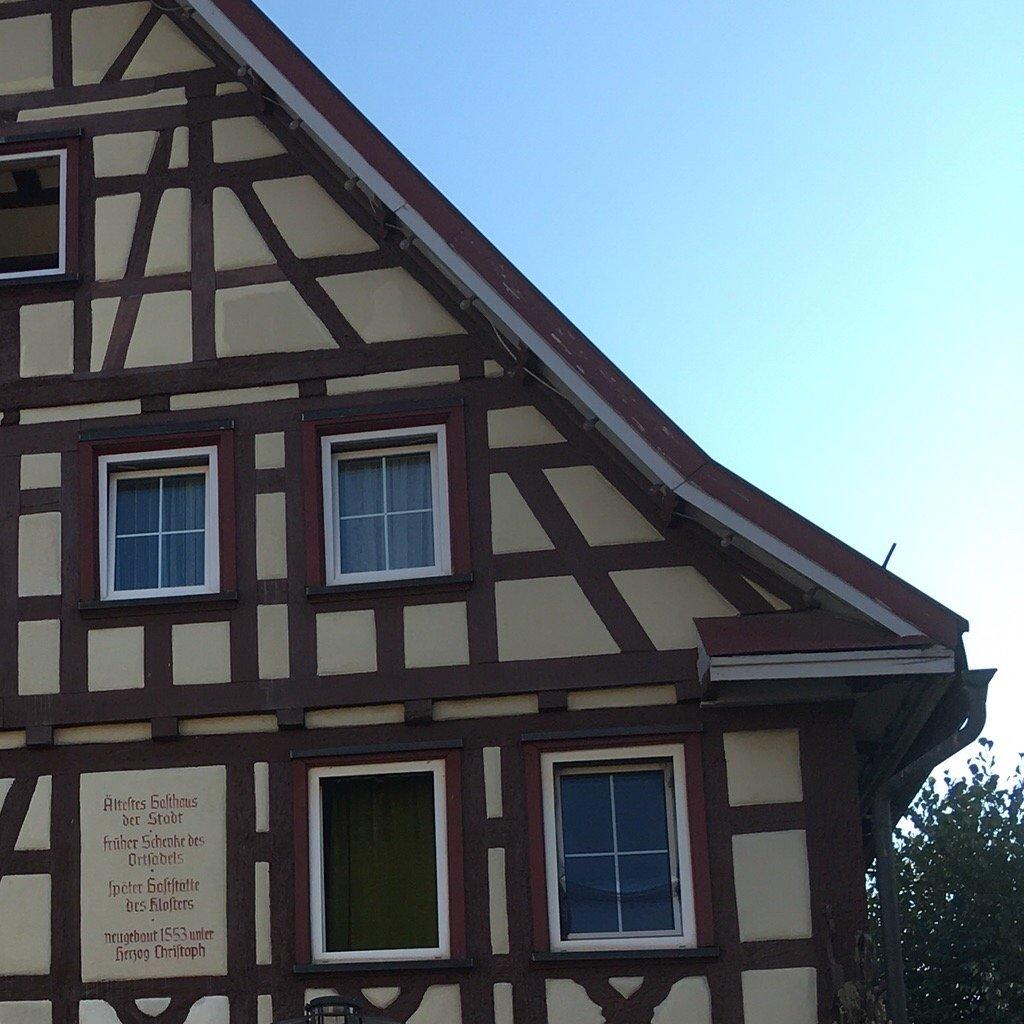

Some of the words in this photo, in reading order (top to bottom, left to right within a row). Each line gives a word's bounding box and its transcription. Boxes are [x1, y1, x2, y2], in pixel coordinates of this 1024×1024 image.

[150, 794, 198, 810] Gasthaus
[122, 813, 141, 826] der
[147, 812, 184, 826] Stadt
[188, 834, 205, 847] des
[126, 898, 146, 912] des
[160, 926, 187, 941] 1553
[187, 928, 214, 941] unter
[115, 946, 149, 962] Herzog
[154, 943, 205, 960] Christoph
